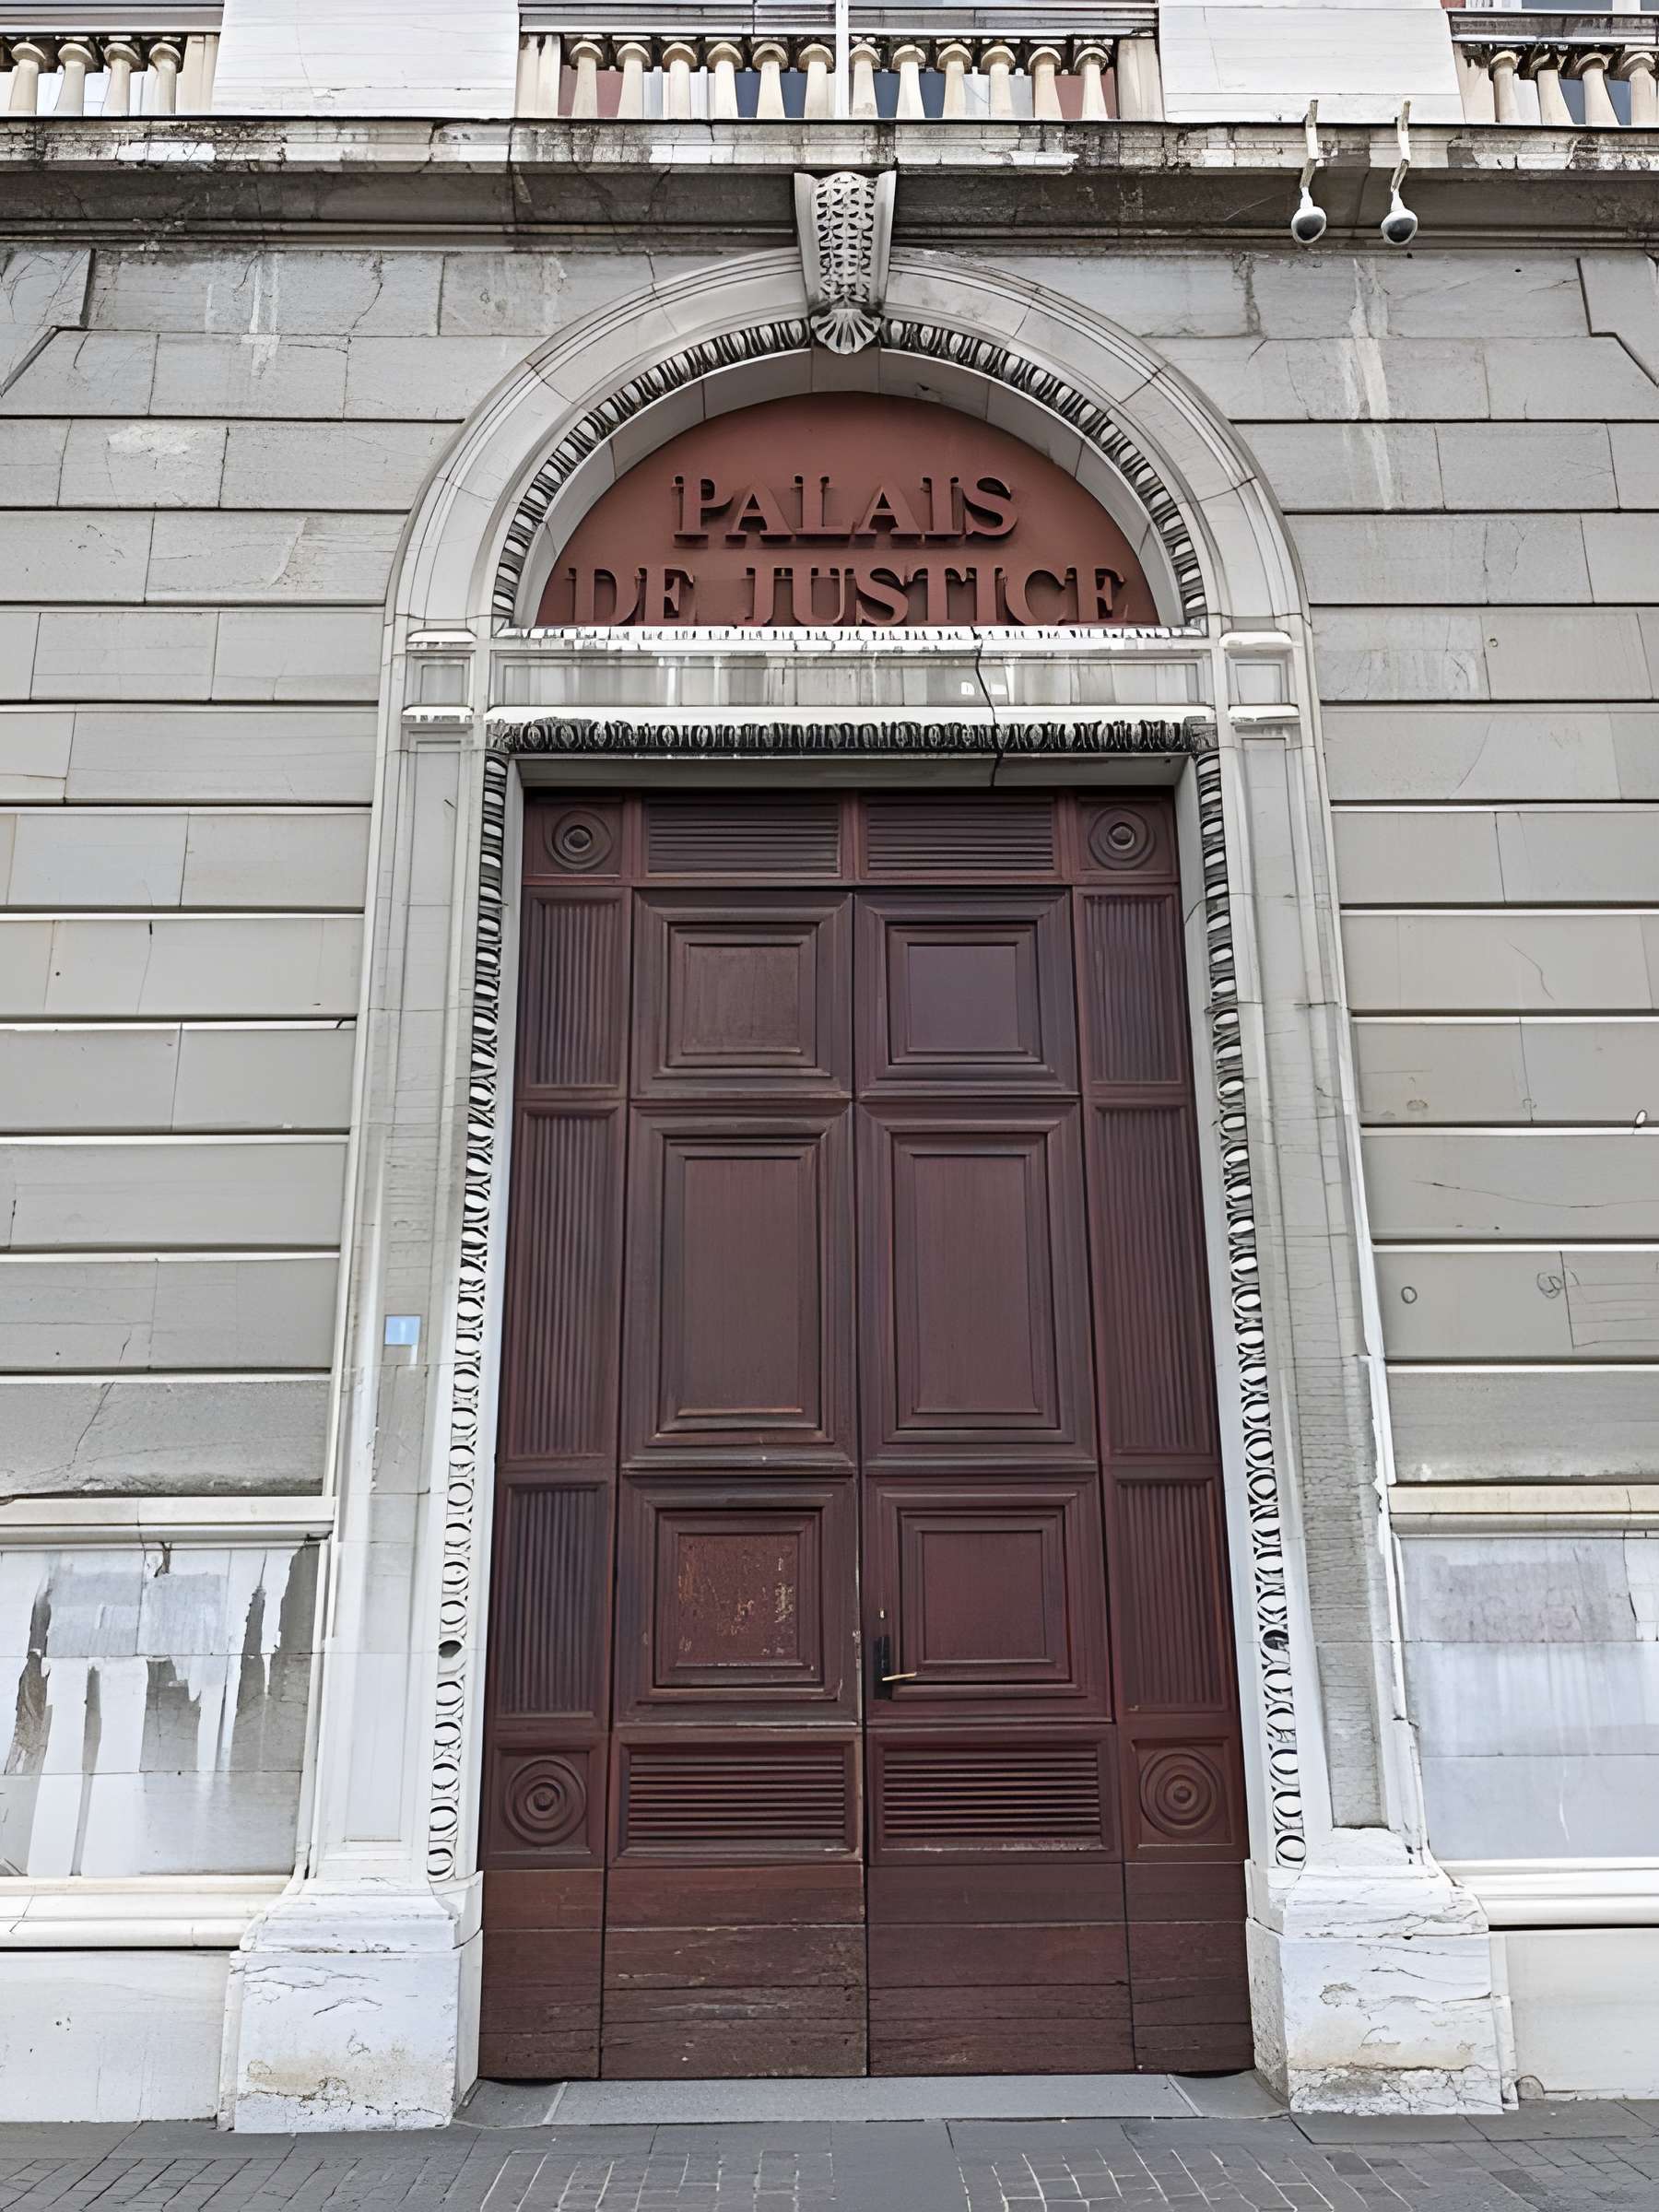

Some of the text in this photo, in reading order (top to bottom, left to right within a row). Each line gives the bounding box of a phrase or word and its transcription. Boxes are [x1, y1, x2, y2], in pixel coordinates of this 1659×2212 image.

[673, 475, 1018, 537] PALAIS
[566, 566, 1128, 626] DE JUSTICE
